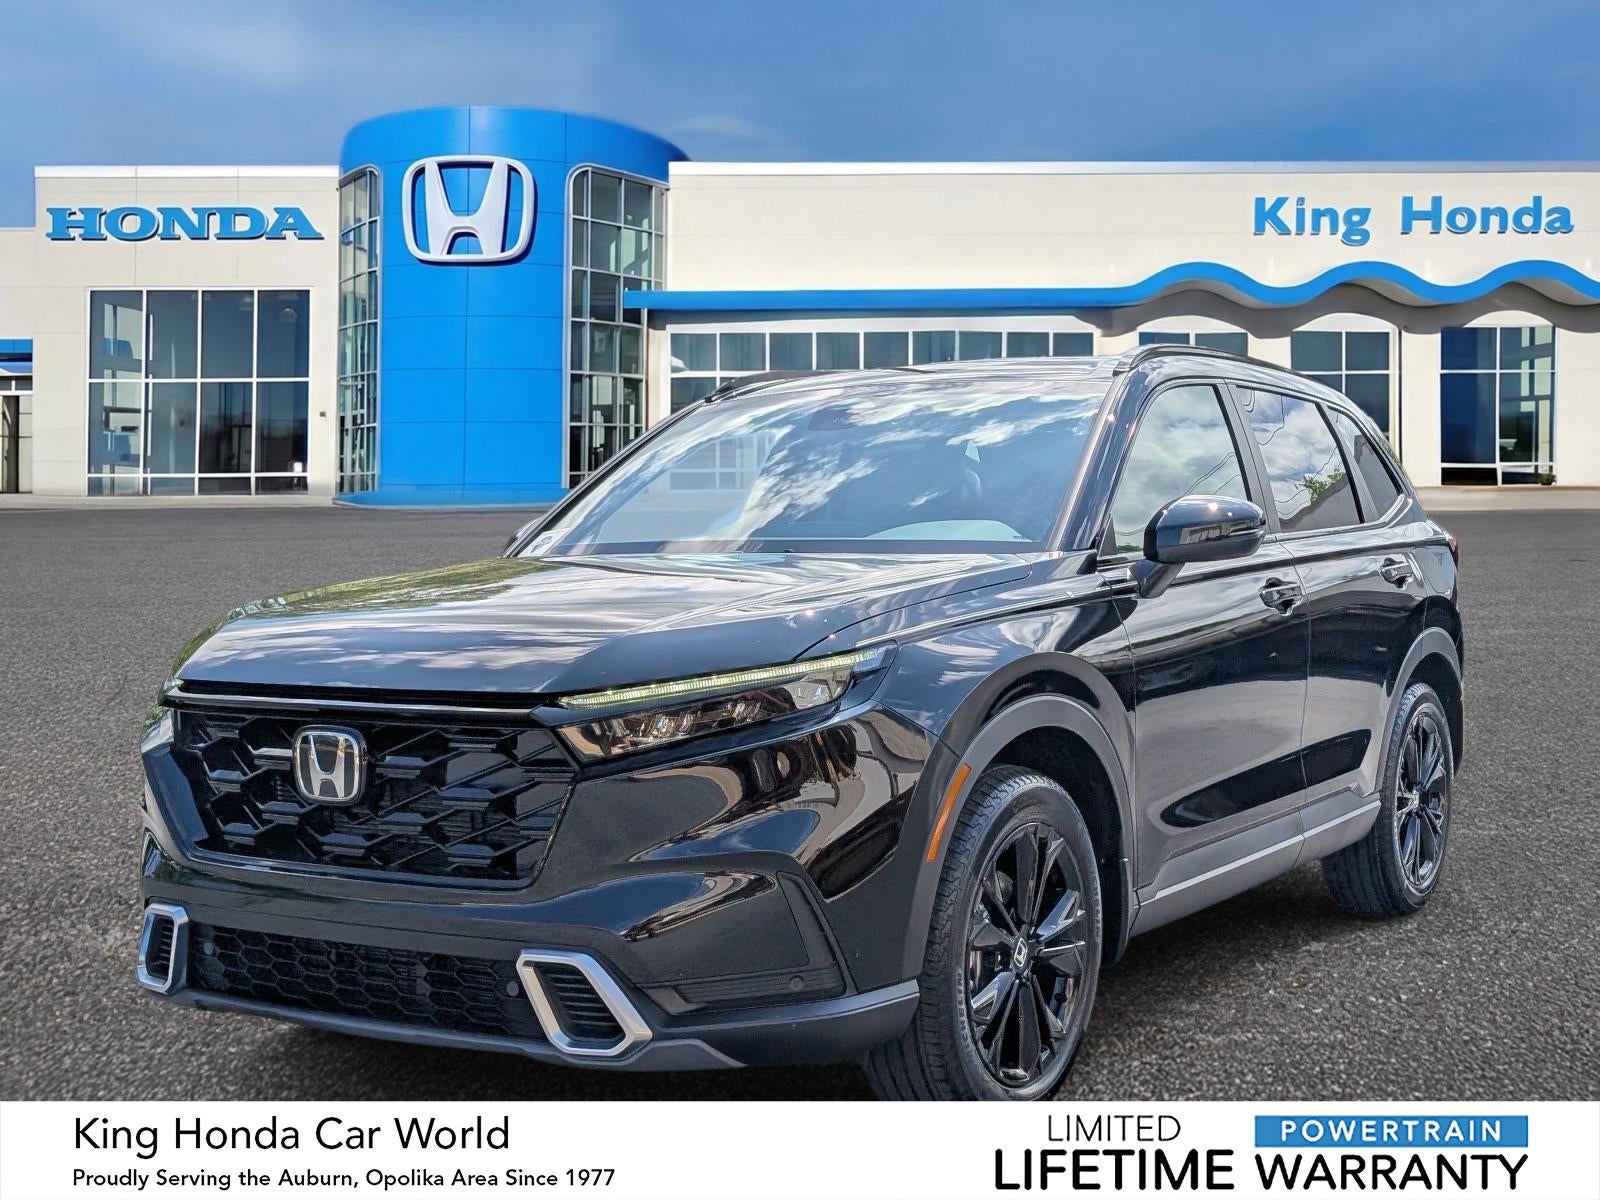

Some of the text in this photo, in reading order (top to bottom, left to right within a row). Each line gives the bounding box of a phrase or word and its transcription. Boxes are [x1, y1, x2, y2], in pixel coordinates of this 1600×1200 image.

[46, 206, 323, 241] HONDA
[1254, 195, 1574, 246] King Honda
